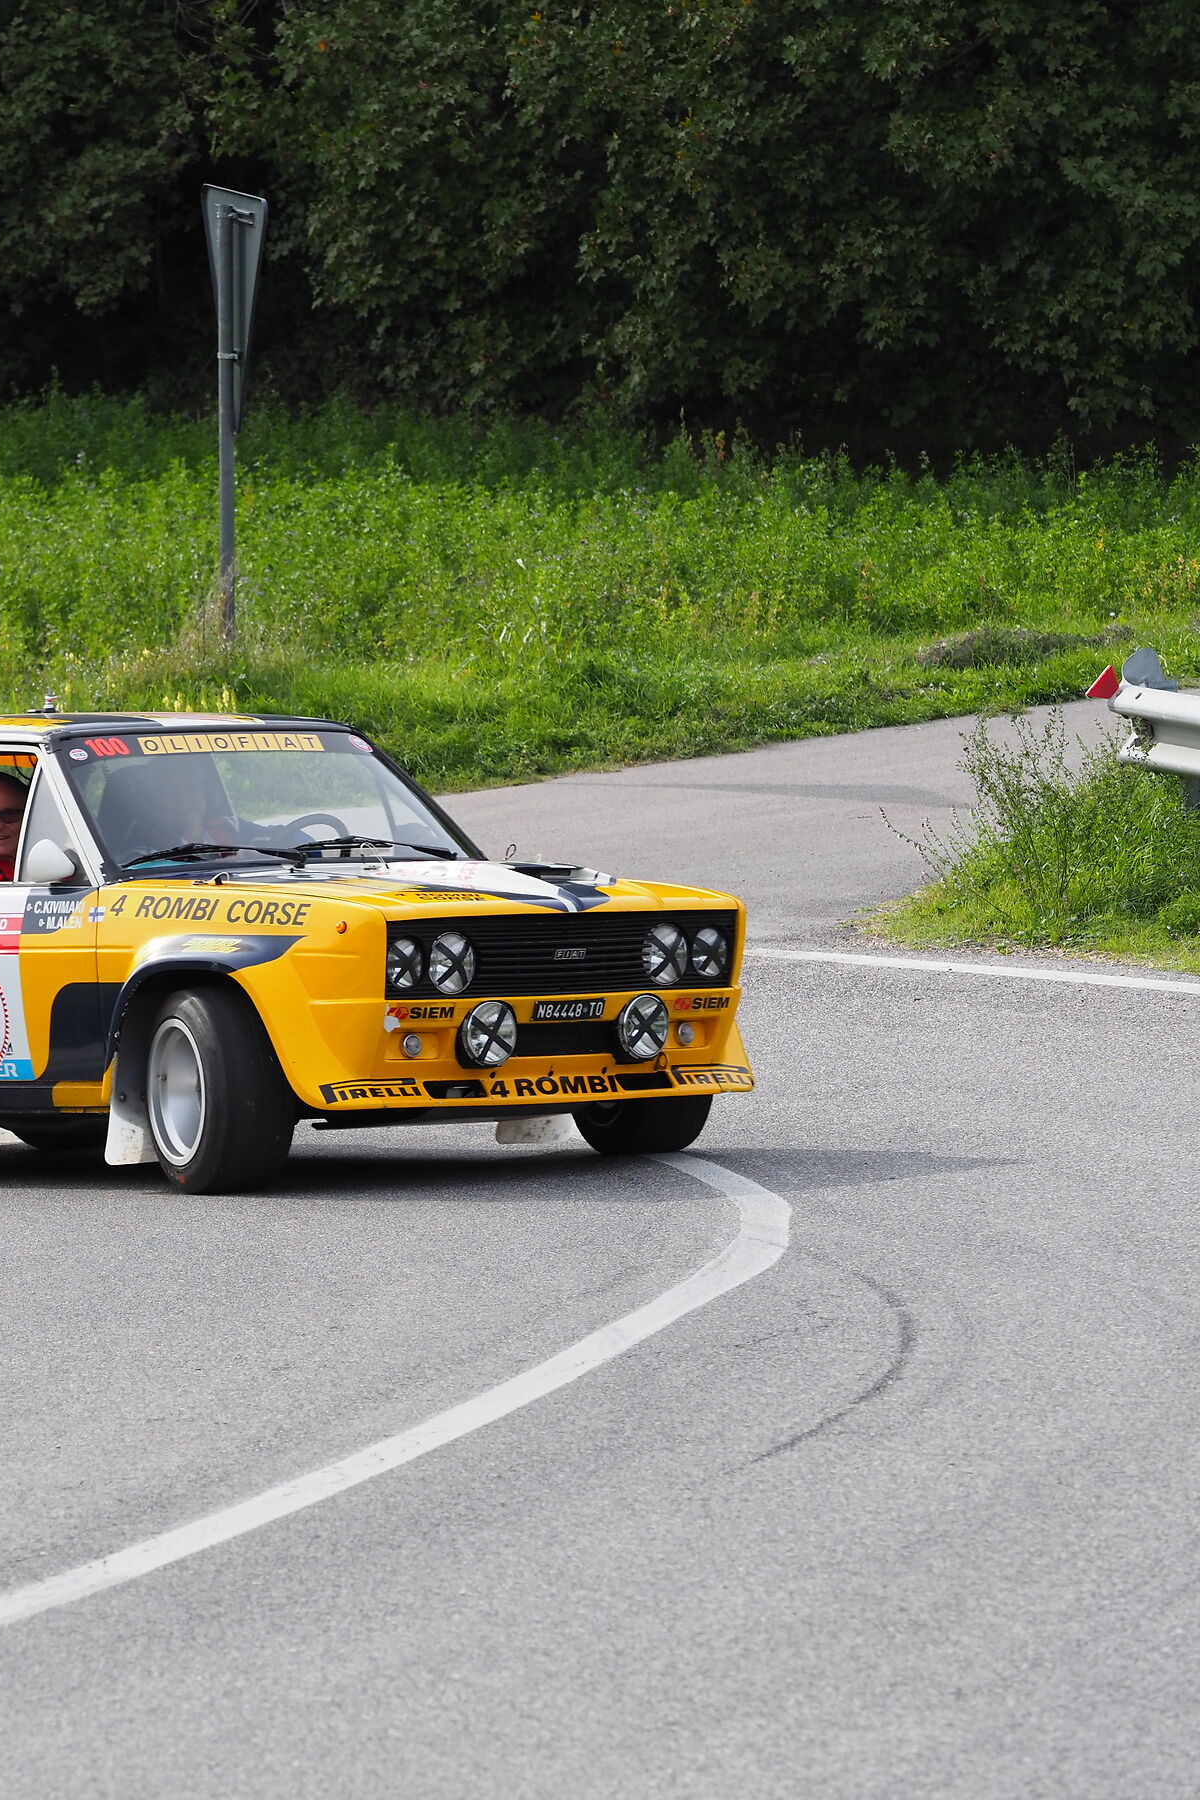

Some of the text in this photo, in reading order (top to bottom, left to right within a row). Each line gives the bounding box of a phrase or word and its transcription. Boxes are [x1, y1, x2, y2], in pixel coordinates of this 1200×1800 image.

[85, 737, 130, 757] 100
[109, 894, 312, 926] 4 ROMBI CORSE
[556, 950, 586, 958] FIAT
[536, 1003, 582, 1019] N84448
[692, 997, 730, 1010] SIEM
[408, 1006, 455, 1020] SIEM
[318, 1077, 423, 1105] PIRELLI
[490, 1074, 619, 1098] 4 ROMBI
